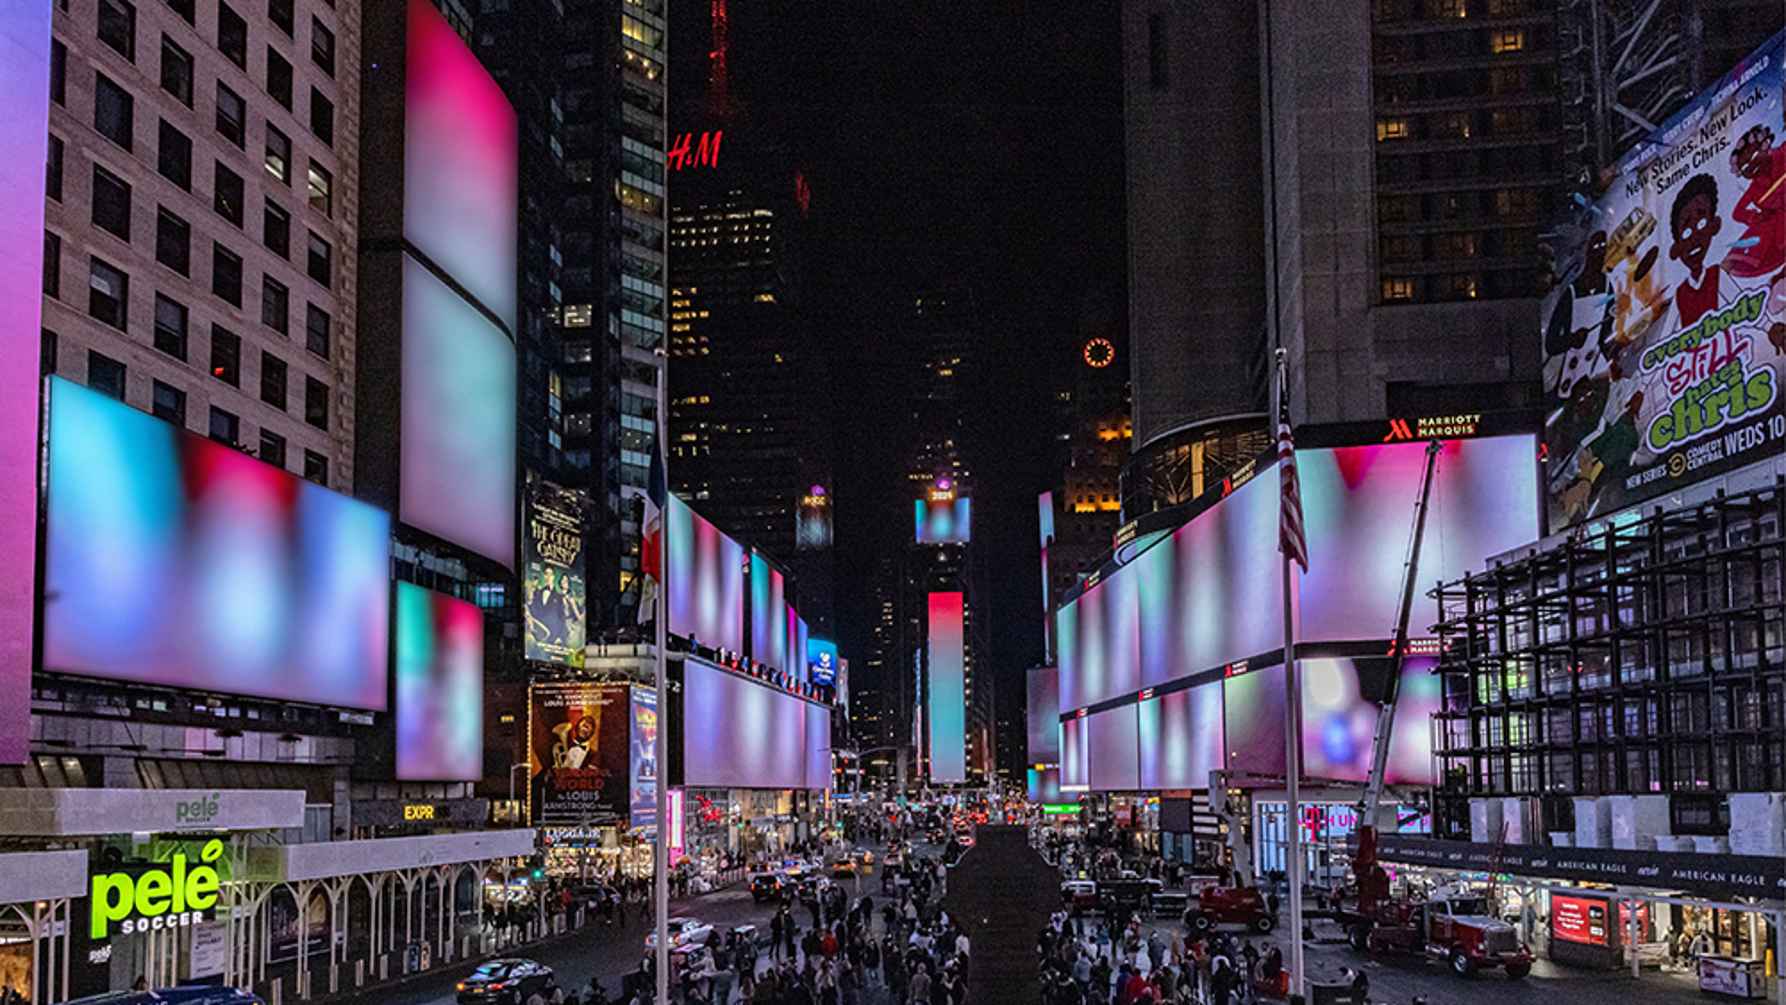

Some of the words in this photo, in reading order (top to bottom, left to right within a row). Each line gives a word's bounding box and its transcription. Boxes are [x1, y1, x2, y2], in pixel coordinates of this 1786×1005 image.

[667, 130, 723, 171] H&M
[1625, 171, 1650, 199] New
[1651, 140, 1698, 181] Stories.
[1700, 115, 1728, 144] New
[1730, 86, 1768, 122] Look.
[1656, 163, 1690, 195] Same
[1691, 136, 1731, 169] Chris.
[1643, 292, 1767, 369] everybody
[1418, 414, 1480, 427] MARRIOTT
[1650, 371, 1772, 449] chris
[1418, 424, 1474, 437] MARQUIS
[1725, 423, 1766, 456] WEDS
[1686, 438, 1723, 460] COMEDY
[1686, 450, 1725, 471] CENTRAL
[544, 801, 596, 811] ARMSTRONG
[566, 790, 600, 801] LOUIS
[1556, 861, 1598, 872] AMERICAN
[1601, 862, 1627, 874] EAGLE
[1671, 869, 1727, 883] AMERICAN
[1730, 873, 1766, 886] EAGLE
[91, 838, 224, 939] pelé
[122, 911, 203, 934] SOCCER
